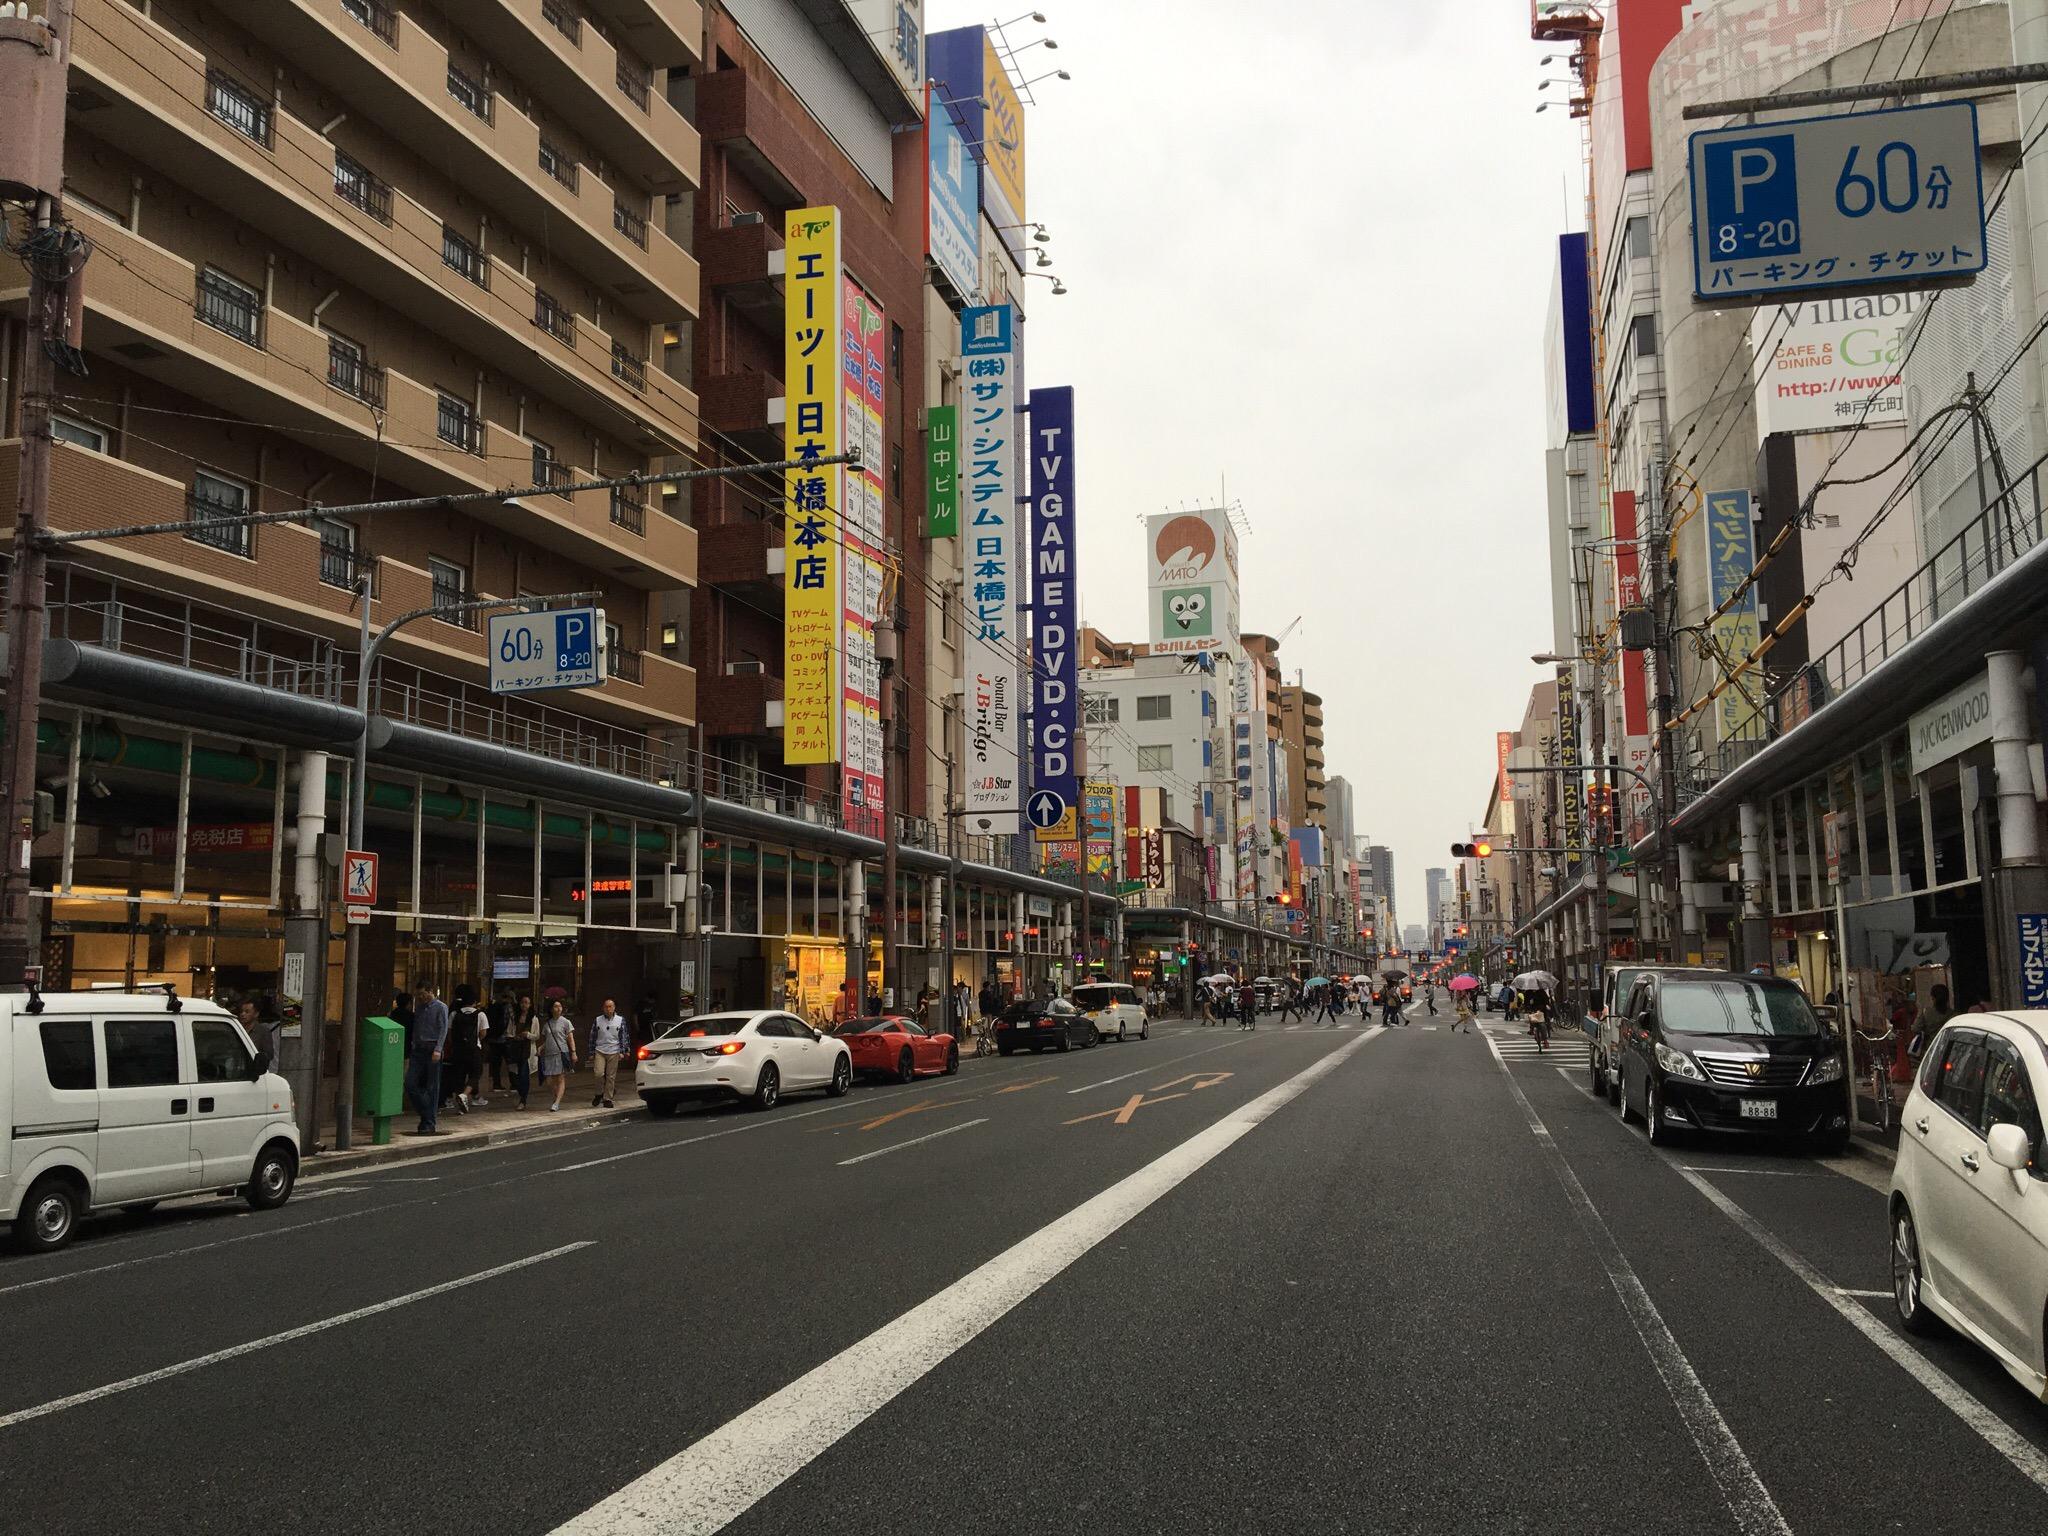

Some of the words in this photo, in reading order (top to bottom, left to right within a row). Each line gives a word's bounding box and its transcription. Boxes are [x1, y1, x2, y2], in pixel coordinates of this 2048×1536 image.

[1732, 147, 1777, 215] P
[1835, 141, 1952, 218] 60分
[1718, 219, 1796, 253] 8-20
[1711, 245, 1973, 288] パーキング・チケット
[1775, 345, 1816, 359] CAFE
[1822, 343, 1833, 353] &
[1777, 355, 1833, 370] DINING
[794, 252, 827, 589] エーツー日本橋本店
[933, 424, 951, 519] 山中ビル
[1158, 567, 1198, 582] MATO
[566, 618, 584, 649] P
[500, 627, 543, 662] 60分
[1154, 638, 1223, 653] 中川ムセン
[560, 651, 590, 668] 8-20
[793, 667, 826, 677] コミック
[495, 672, 592, 689] パーキング・チケット
[797, 682, 823, 692] アニメ
[792, 740, 826, 750] アダルト
[1631, 751, 1647, 761] 5F
[868, 784, 880, 797] TAX
[995, 776, 1012, 790] Star
[973, 791, 1010, 802] プロダクション
[191, 828, 243, 846] 免税店
[388, 1032, 399, 1044] 60
[1748, 1106, 1775, 1117] 88-88
